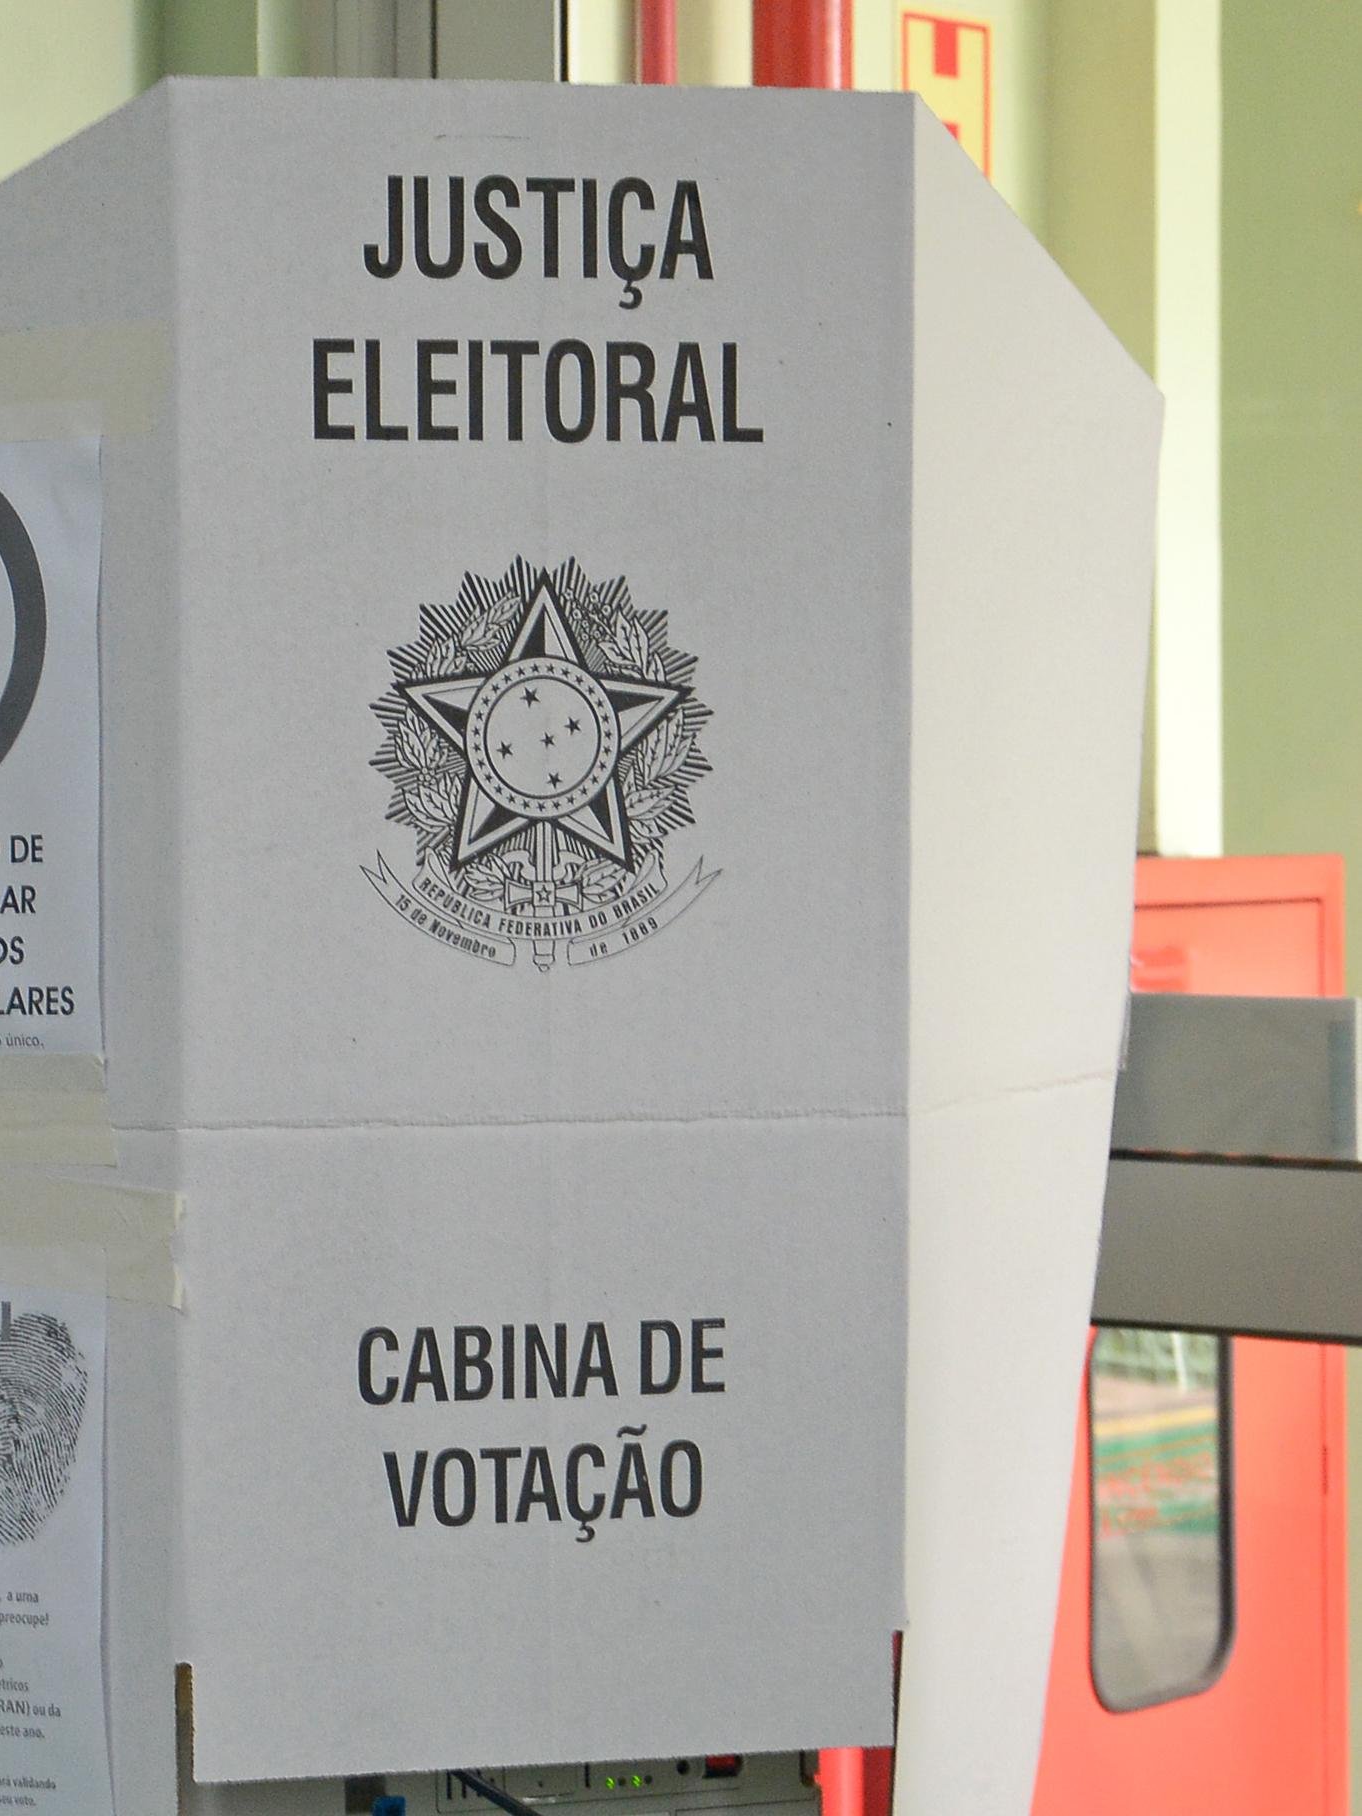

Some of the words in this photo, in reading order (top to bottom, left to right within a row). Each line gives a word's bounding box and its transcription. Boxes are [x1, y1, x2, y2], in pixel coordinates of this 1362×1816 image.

[363, 174, 714, 310] JUSTIÇA
[313, 338, 764, 444] ELEITORAL
[9, 833, 44, 864] DE
[395, 894, 412, 912] 15
[410, 908, 428, 926] de
[429, 918, 497, 958] Novembro
[498, 917, 582, 937] FEDERATIVA
[588, 910, 608, 929] DO
[612, 882, 660, 919] BRASIL
[357, 1321, 619, 1406] CABINA
[639, 1317, 726, 1395] DE
[383, 1423, 704, 1543] VOTAÇÃO
[48, 1703, 61, 1718] da
